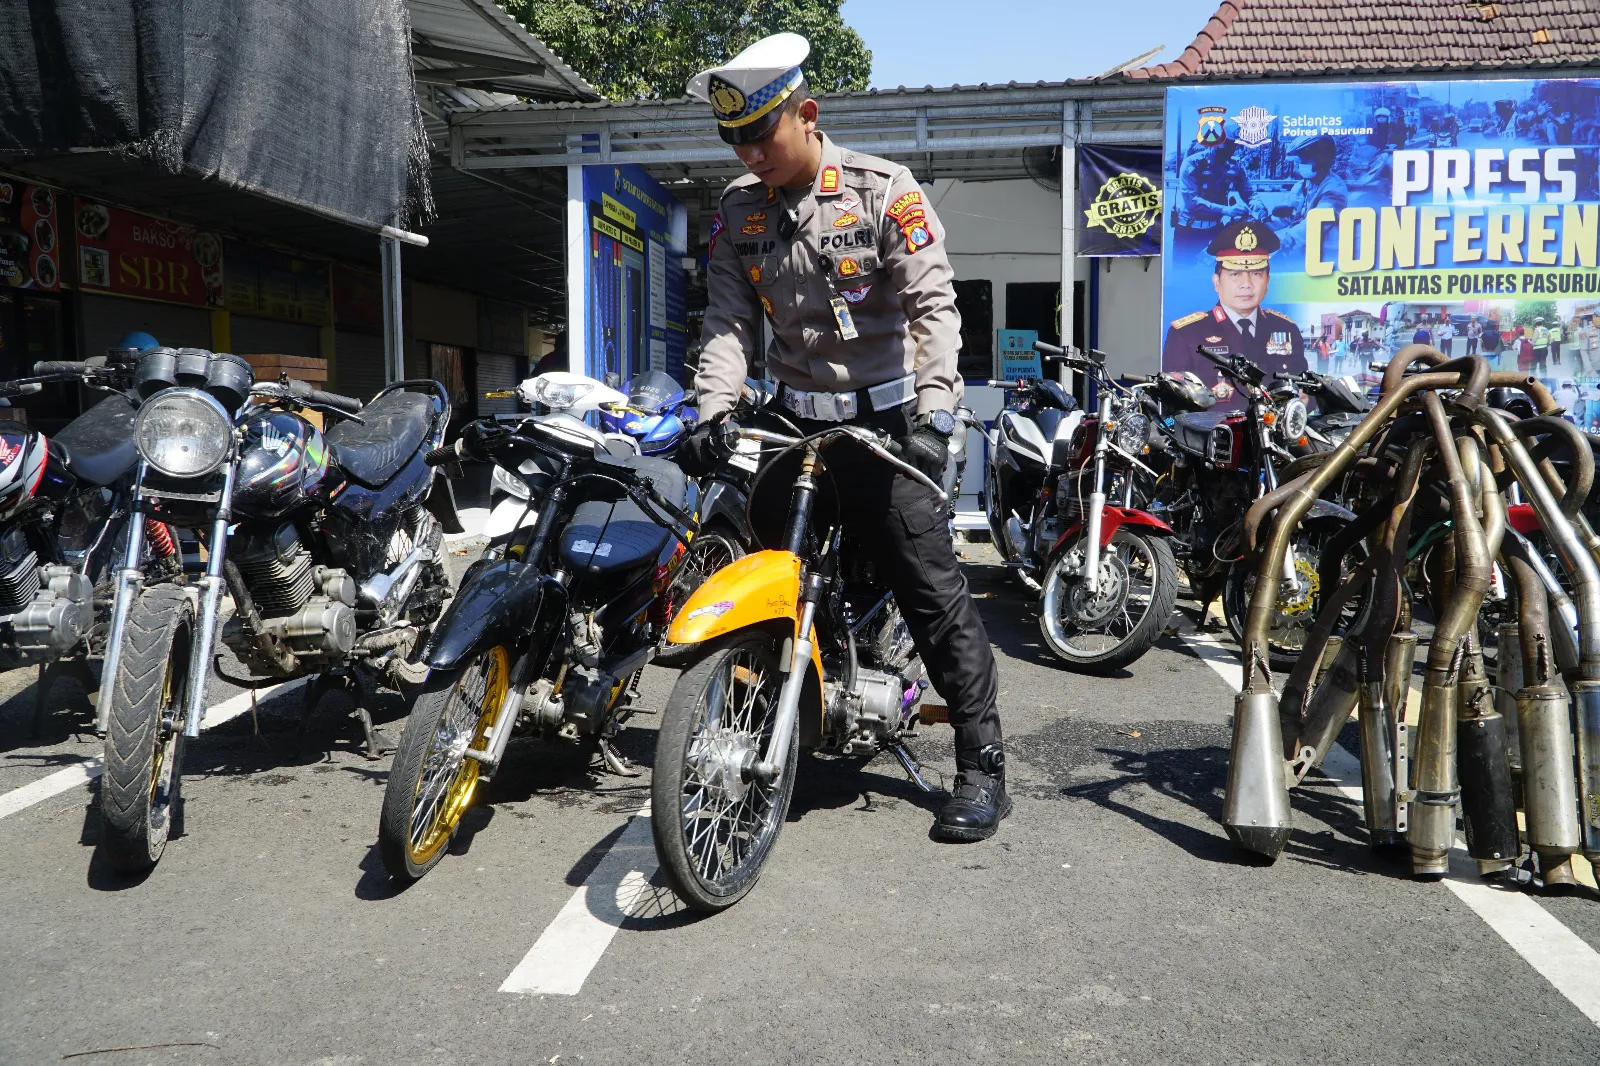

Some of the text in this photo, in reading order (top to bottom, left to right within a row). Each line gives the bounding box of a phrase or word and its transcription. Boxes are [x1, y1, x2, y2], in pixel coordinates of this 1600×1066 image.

[1282, 114, 1342, 127] Satlantas
[1283, 126, 1373, 137] Polres Pasuruan
[1106, 177, 1143, 193] GRATIS
[1391, 147, 1577, 206] PRESS
[1097, 194, 1159, 217] GRATIS
[1112, 217, 1149, 234] GRATIS
[132, 225, 176, 249] BAKSO
[761, 240, 776, 255] AP
[820, 229, 874, 250] POLRI
[1305, 203, 1599, 277] CONFEREN
[119, 252, 190, 297] SBR
[1337, 272, 1600, 297] SATLANTAS POLRES PASURU
